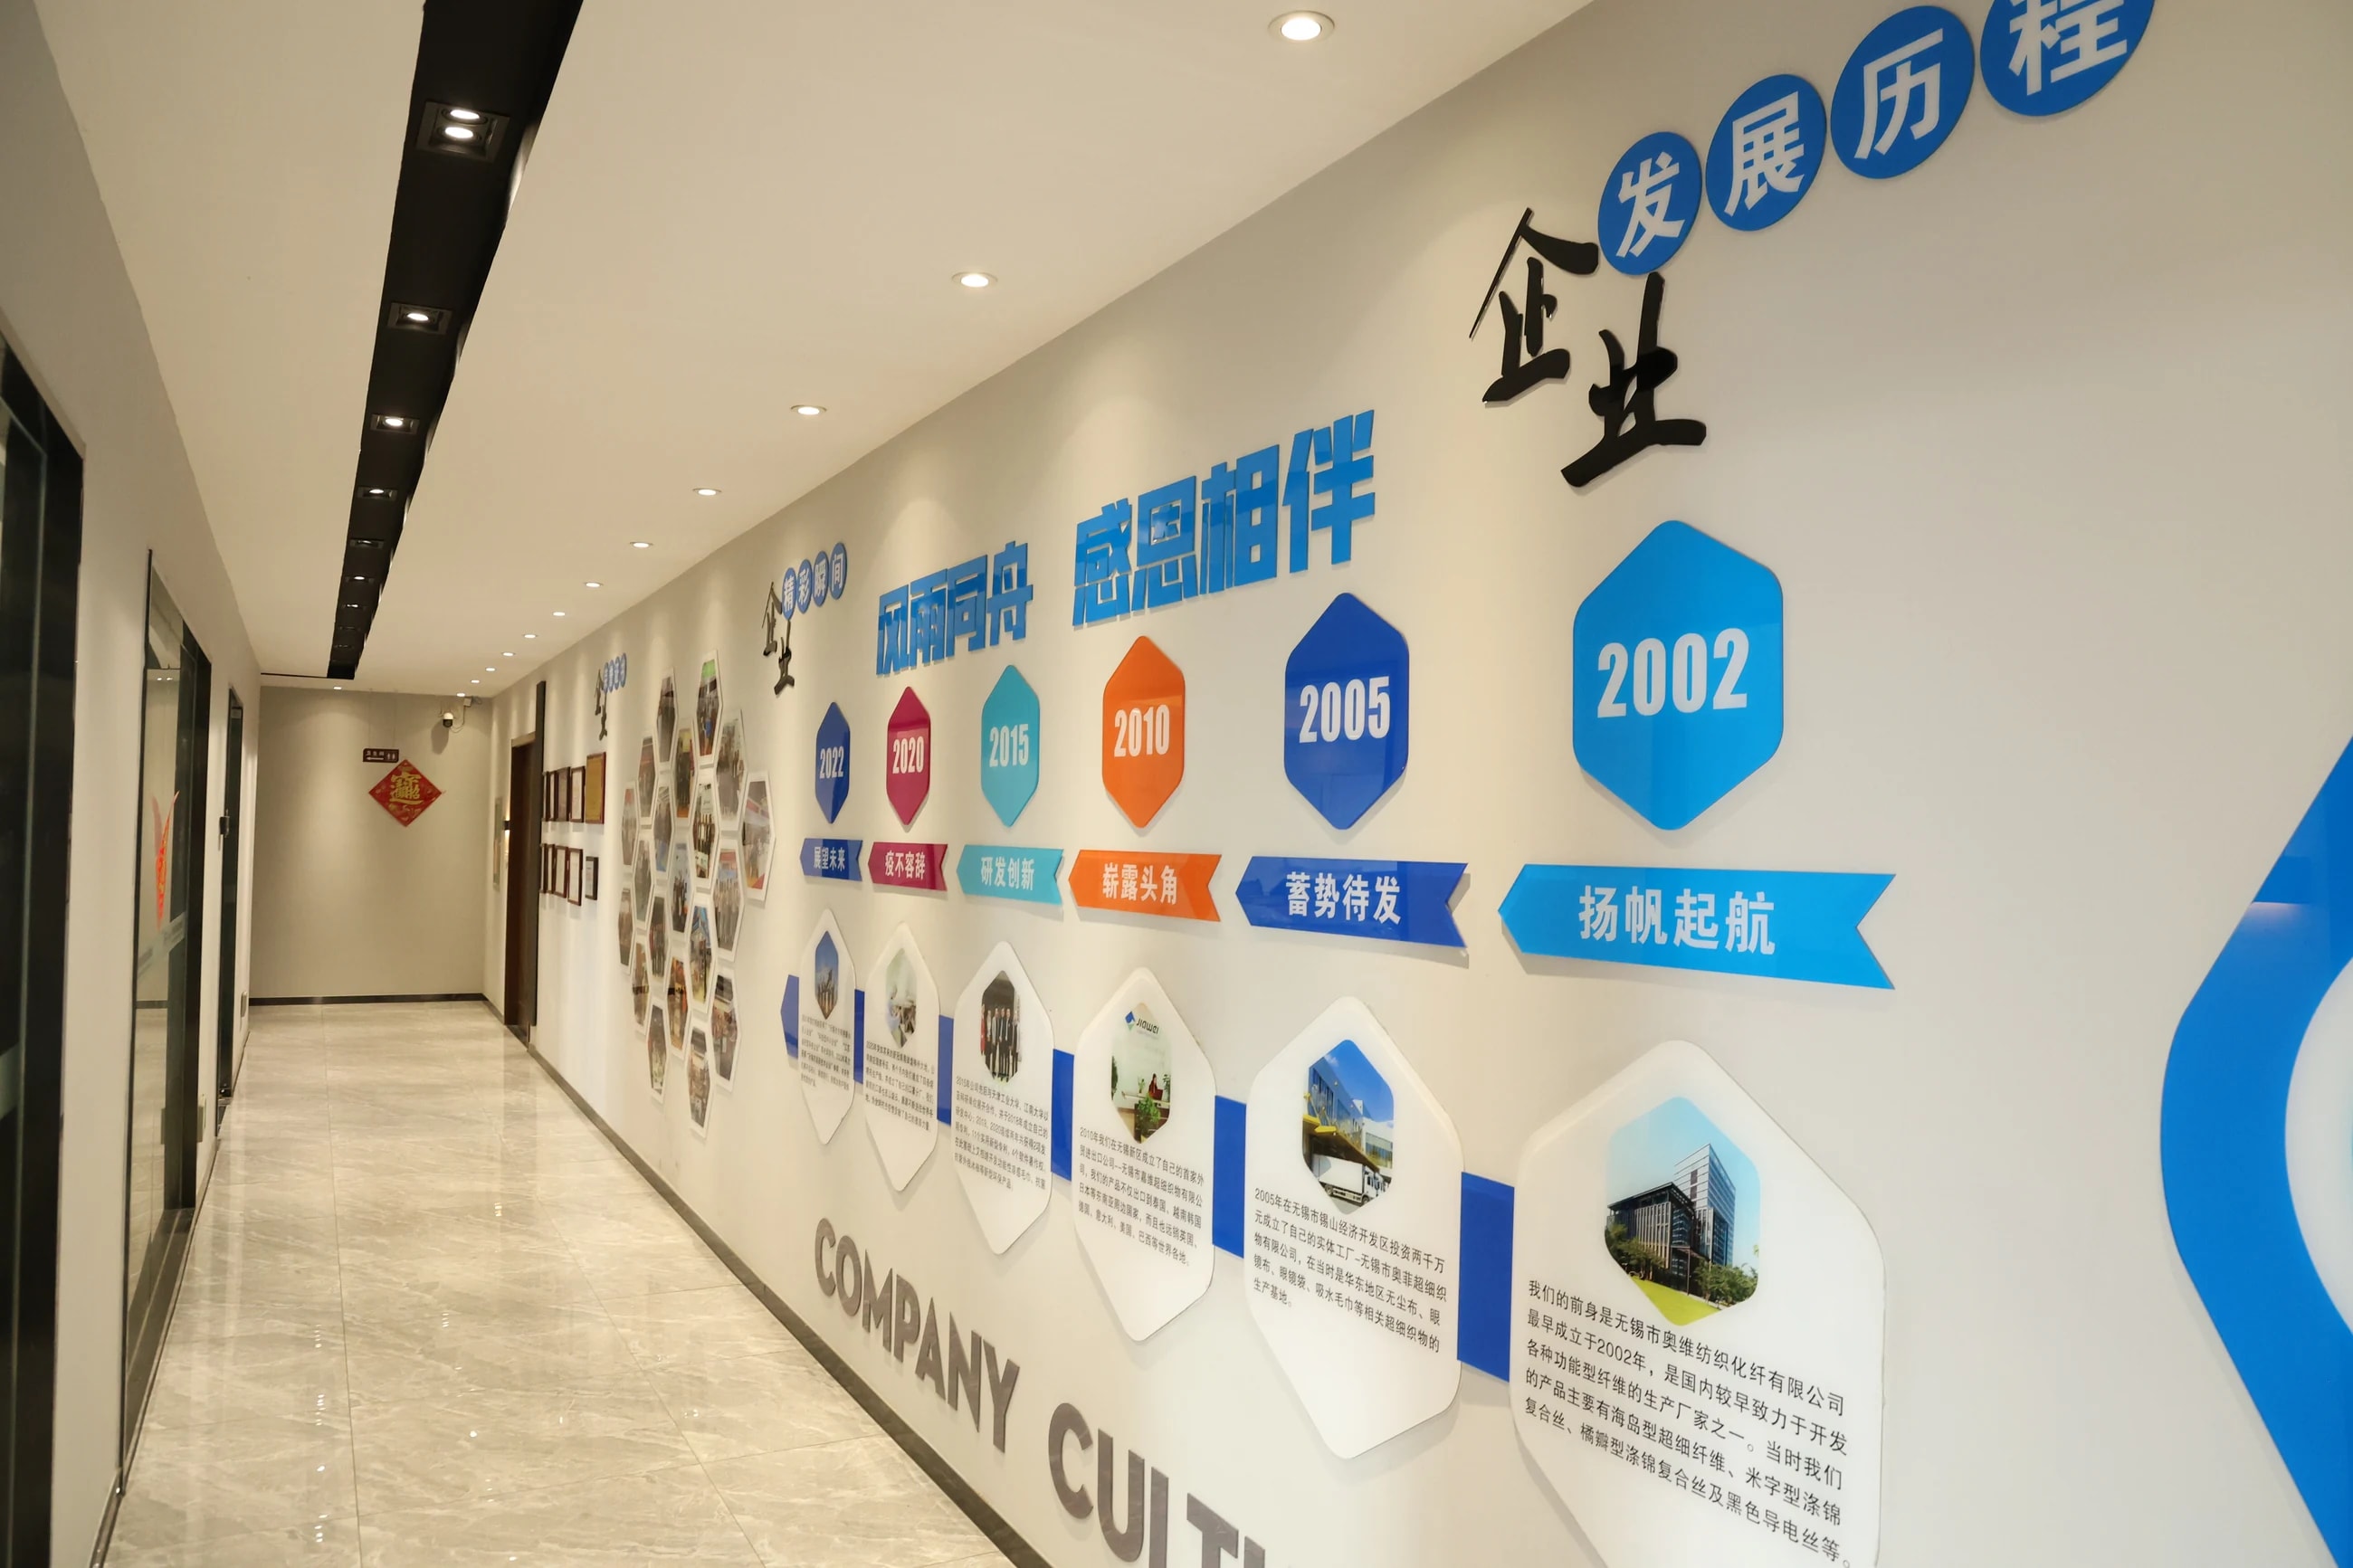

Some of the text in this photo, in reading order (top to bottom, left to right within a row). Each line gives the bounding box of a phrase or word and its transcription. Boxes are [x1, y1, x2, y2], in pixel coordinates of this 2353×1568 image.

[1615, 0, 2129, 256] 发展历程
[1469, 206, 1707, 488] 企业
[1072, 410, 1375, 626] 感恩相伴
[784, 553, 843, 612] 精彩瞬间
[876, 541, 1033, 675] 风雨同舟
[1299, 677, 1391, 744] 2005
[1597, 628, 1749, 718] 2002
[820, 746, 843, 779] 2022
[892, 736, 924, 774] 2020
[989, 724, 1029, 767] 2015
[1114, 704, 1170, 757] 2010
[814, 846, 845, 872] 展望未来
[885, 851, 926, 880] 疫不容辞
[980, 857, 1034, 890] 研发创新
[1102, 863, 1177, 906] 崭露头角
[1286, 872, 1401, 925] 蓄势待发
[1578, 885, 1776, 955] 扬帆起航
[1080, 1126, 1204, 1185] 2010年我们在无锡新区成立了自己的首家外
[1254, 1188, 1444, 1274] 2005年在无锡市锡山经济开发区投资两千万
[1253, 1231, 1441, 1326] 物有限公司，在当时是华东地区无尘布、眼
[1253, 1277, 1292, 1307] 生产基地。
[1253, 1253, 1440, 1353] 镜布、眼镜袋、吸水毛巾等相关超细织物的
[1527, 1308, 1848, 1457] 最早成立于2002年，是国内较早致力于开发
[1528, 1279, 1844, 1416] 我们的前身是无锡市奥维纺织化纤有限公司
[814, 1218, 1265, 1568] COMPANY CULT
[1526, 1340, 1843, 1491] 各种功能型纤维的生产厂家之一。当时我们
[1524, 1398, 1851, 1568] 复合丝、橘瓣型涤锦复合丝及黑色导电丝等。
[1525, 1369, 1842, 1526] 的产品主要有海岛型超细纤维、米字型涤锦
